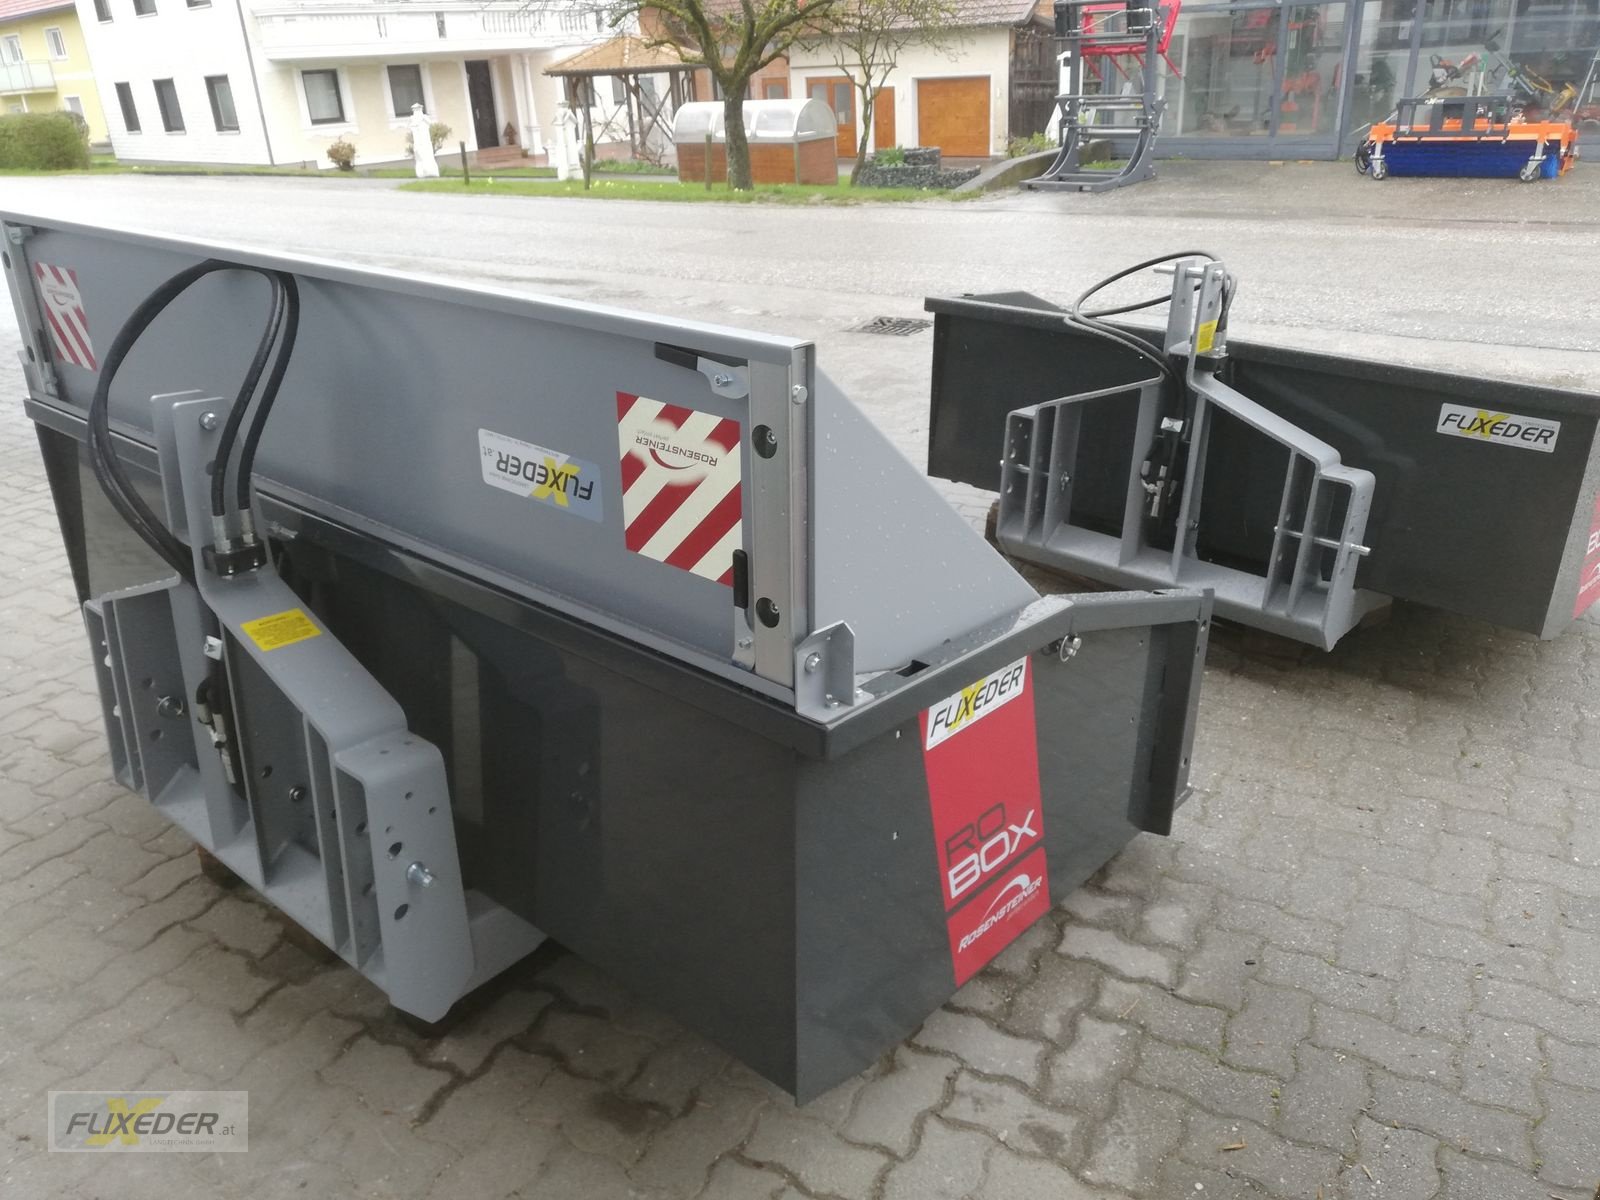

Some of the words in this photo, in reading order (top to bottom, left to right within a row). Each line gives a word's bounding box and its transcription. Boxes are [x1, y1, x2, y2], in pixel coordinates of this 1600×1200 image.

[635, 435, 718, 467] ROSENSTEINER
[1441, 413, 1555, 444] FLIXEDER
[930, 665, 1023, 738] FLIXEDER
[945, 802, 1005, 867] RO
[948, 809, 1037, 899] BOX
[957, 875, 1042, 953] ROSENSTEINER
